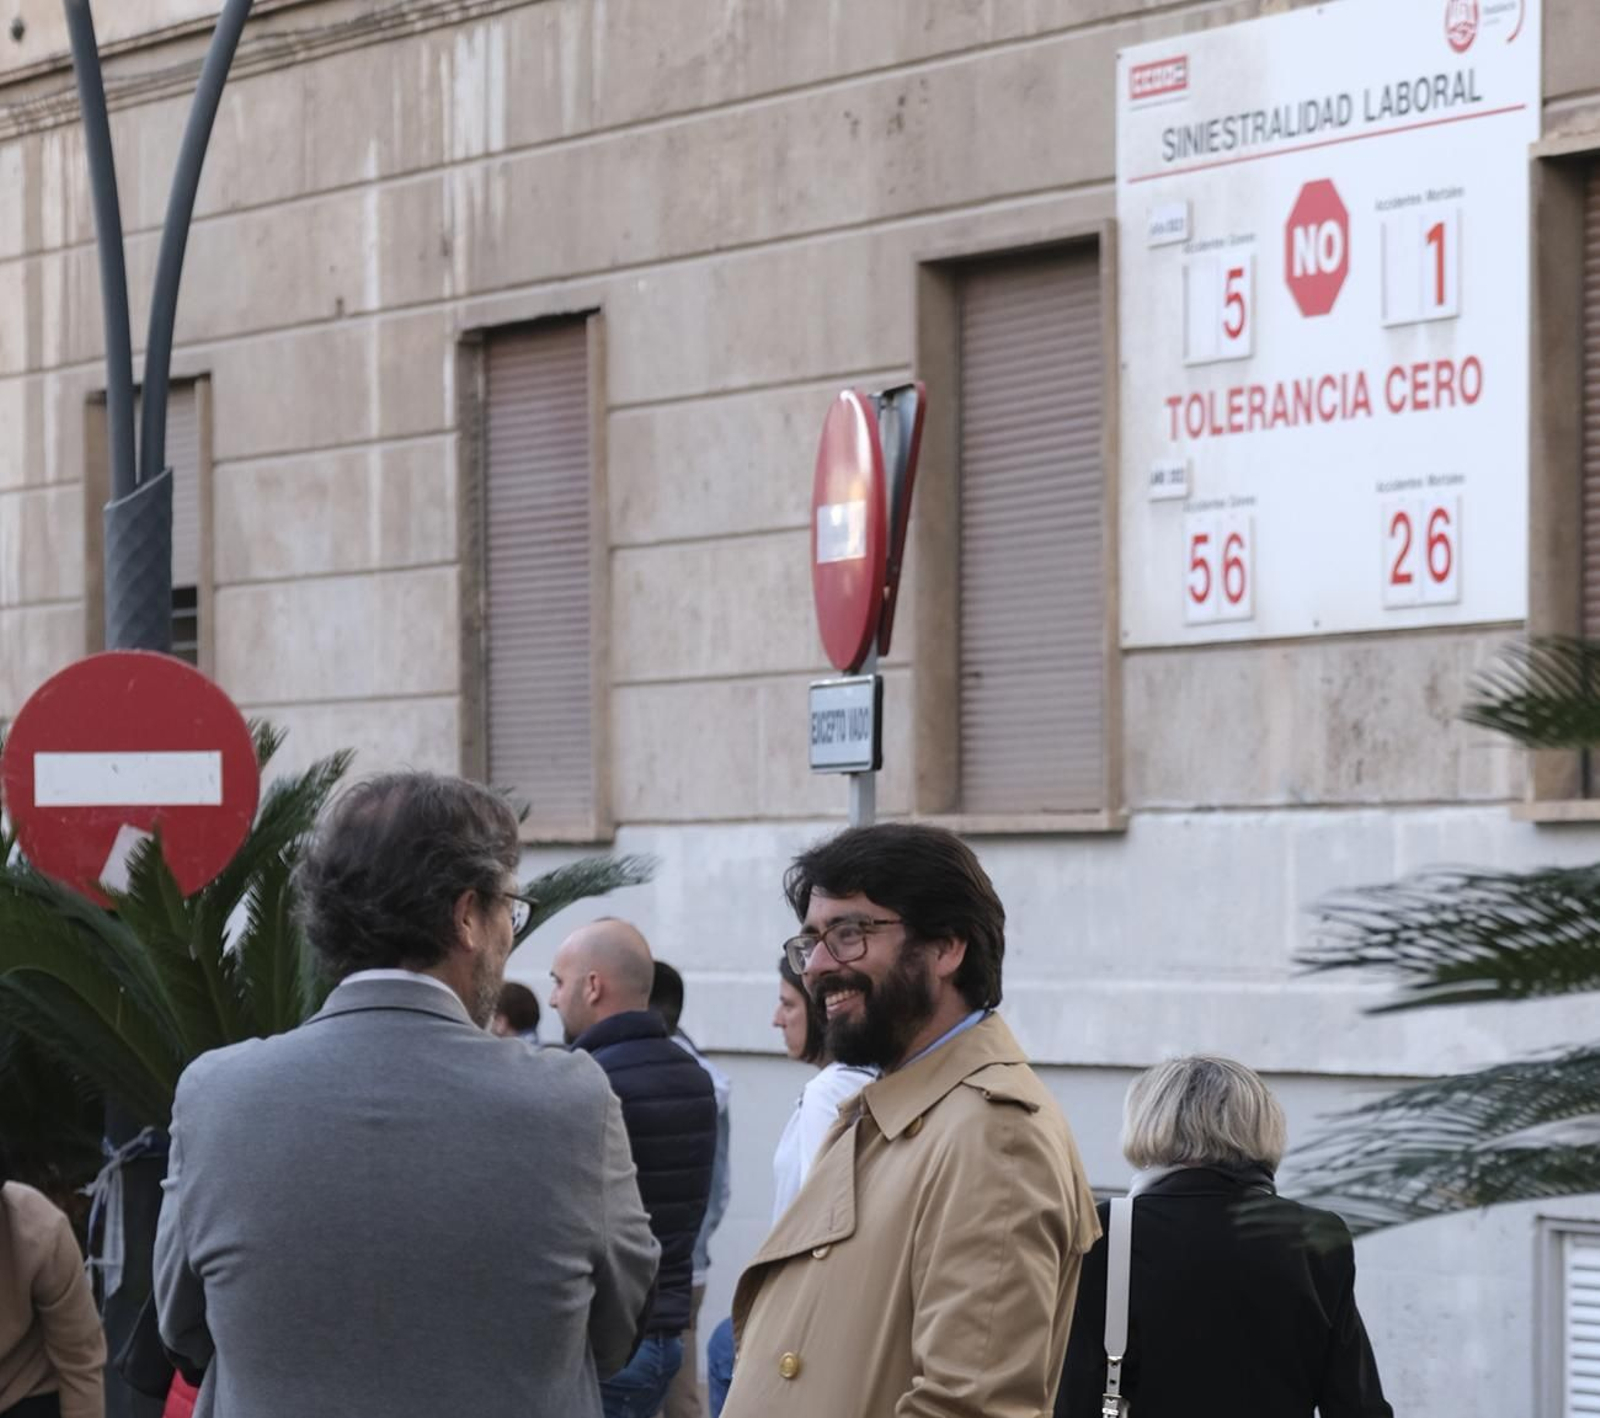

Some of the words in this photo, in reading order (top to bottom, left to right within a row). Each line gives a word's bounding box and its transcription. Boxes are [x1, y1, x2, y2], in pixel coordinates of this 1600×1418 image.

[1162, 94, 1352, 162] SINIESTRALIDAD
[1364, 68, 1483, 122] LABORAL
[1293, 219, 1343, 278] NO
[1426, 222, 1446, 307] 1
[1222, 267, 1247, 340] 5
[1166, 370, 1373, 441] TOLERANCIA
[1384, 355, 1483, 414] CERO
[1188, 532, 1247, 604] 56
[1389, 507, 1453, 584] 26
